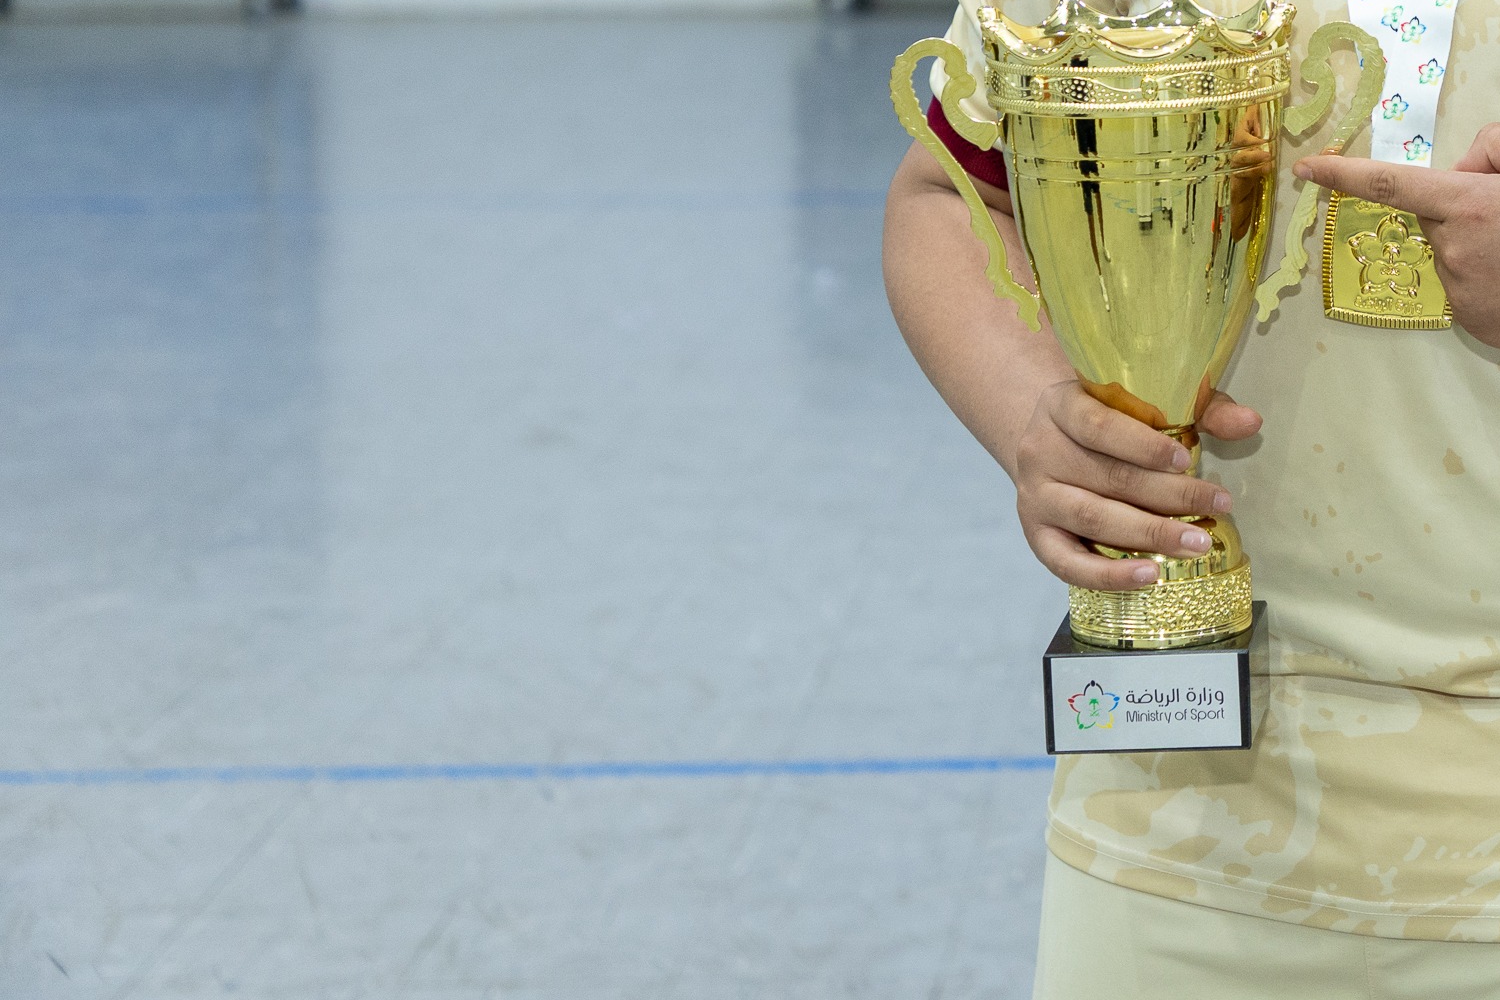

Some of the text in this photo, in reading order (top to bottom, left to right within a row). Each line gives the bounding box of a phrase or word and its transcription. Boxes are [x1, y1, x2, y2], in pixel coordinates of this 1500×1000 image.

[1125, 687, 1225, 708] وزارة الرياضة
[1126, 708, 1225, 724] Ministry of Sport
